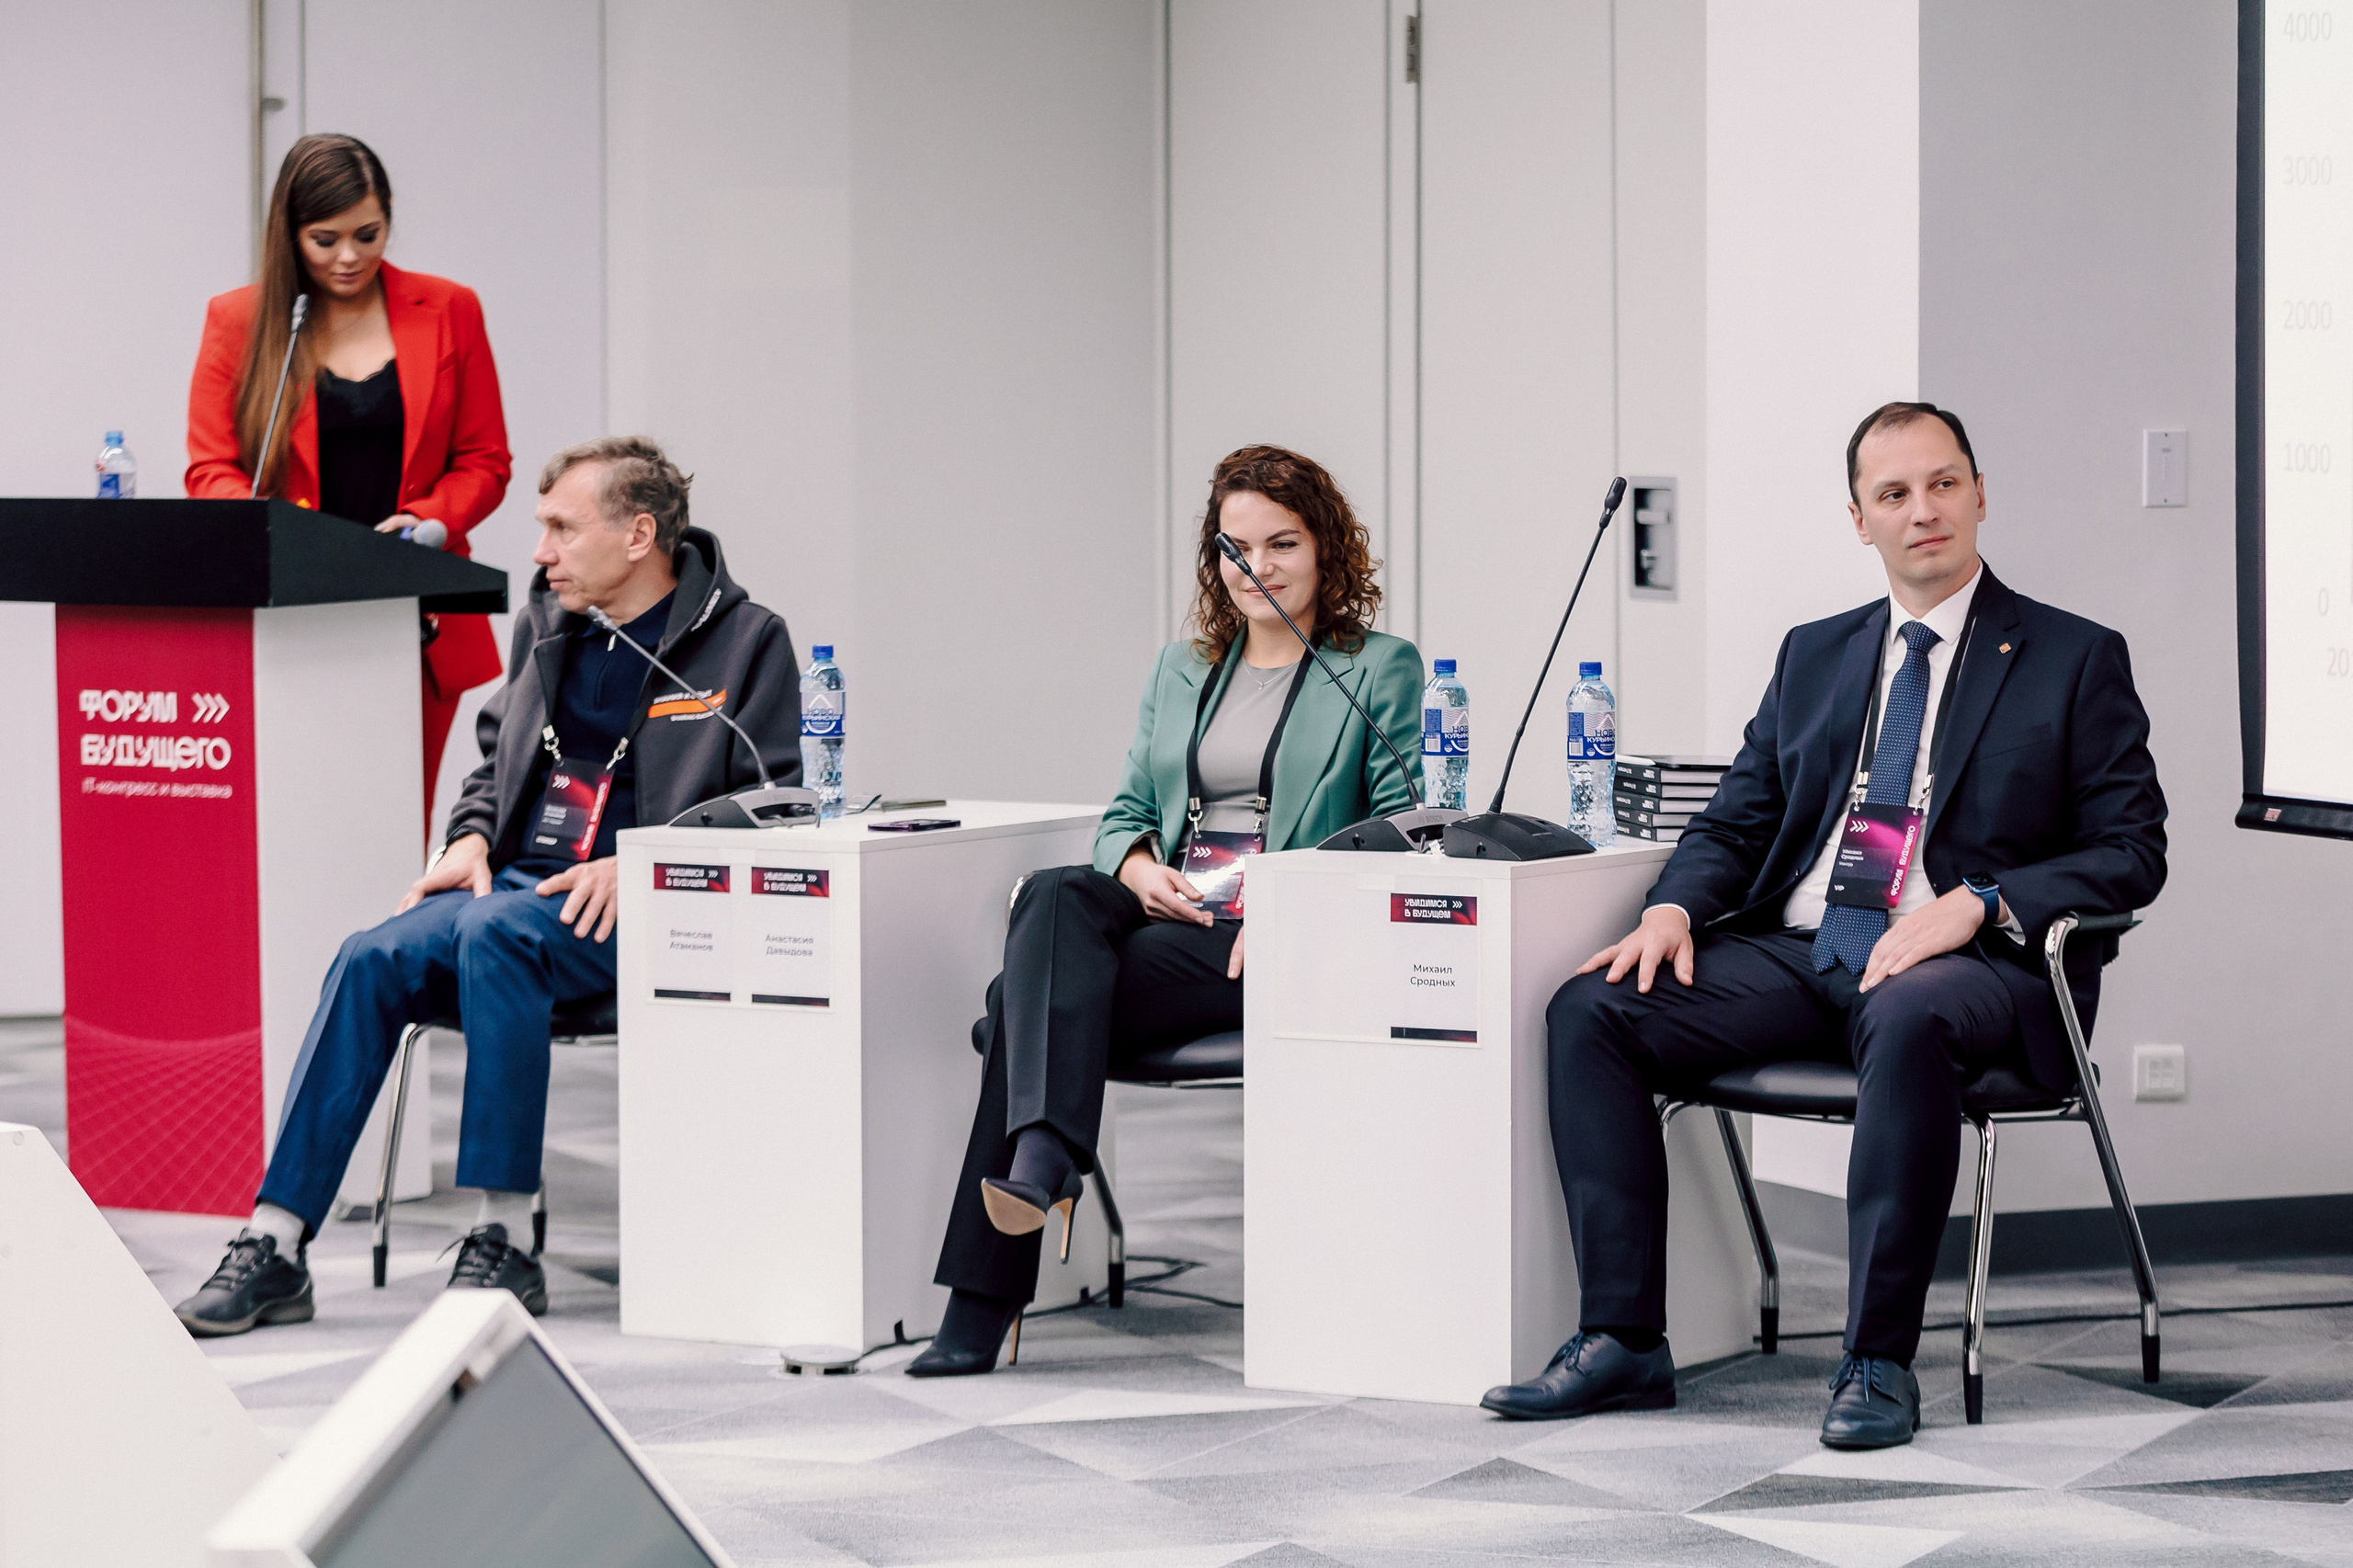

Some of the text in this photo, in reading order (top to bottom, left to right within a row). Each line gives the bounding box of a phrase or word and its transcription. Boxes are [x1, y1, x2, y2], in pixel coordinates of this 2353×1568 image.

[2282, 12, 2333, 43] 4000
[2282, 155, 2333, 187] 3000
[2282, 300, 2333, 332] 2000
[2282, 442, 2332, 474] 1000
[2318, 587, 2329, 617] 0
[2326, 646, 2353, 677] 20
[79, 689, 177, 723] ФОРУМ
[1404, 898, 1448, 908] УВИДИМСЯ
[1413, 909, 1451, 919] БУДУЩЕМ
[670, 929, 712, 940] Вячеслав
[765, 934, 813, 945] Анастасия
[669, 941, 713, 952] Атаманов
[766, 947, 813, 958] Давыдова
[1414, 963, 1452, 974] Михаил
[1410, 976, 1456, 988] Сродных
